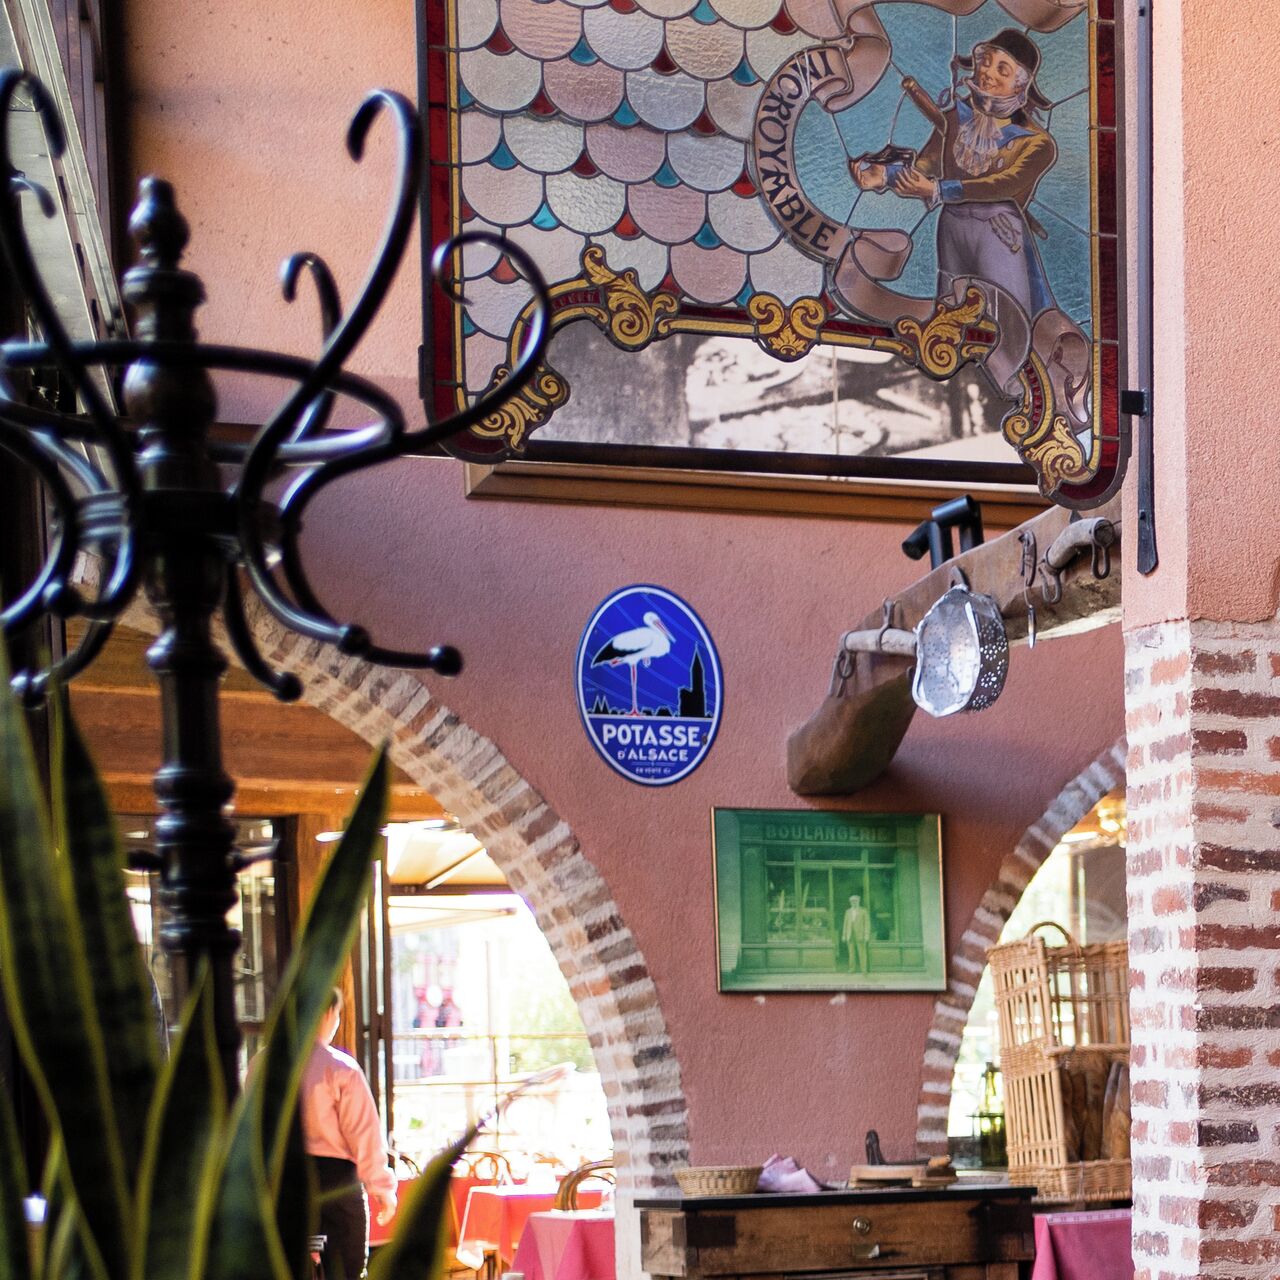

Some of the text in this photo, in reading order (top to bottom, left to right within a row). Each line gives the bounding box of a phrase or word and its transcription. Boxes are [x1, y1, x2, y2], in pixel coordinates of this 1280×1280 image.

[758, 50, 837, 251] INCROYABLE
[602, 723, 700, 747] POTASSE
[765, 823, 889, 841] BOULANGERIE
